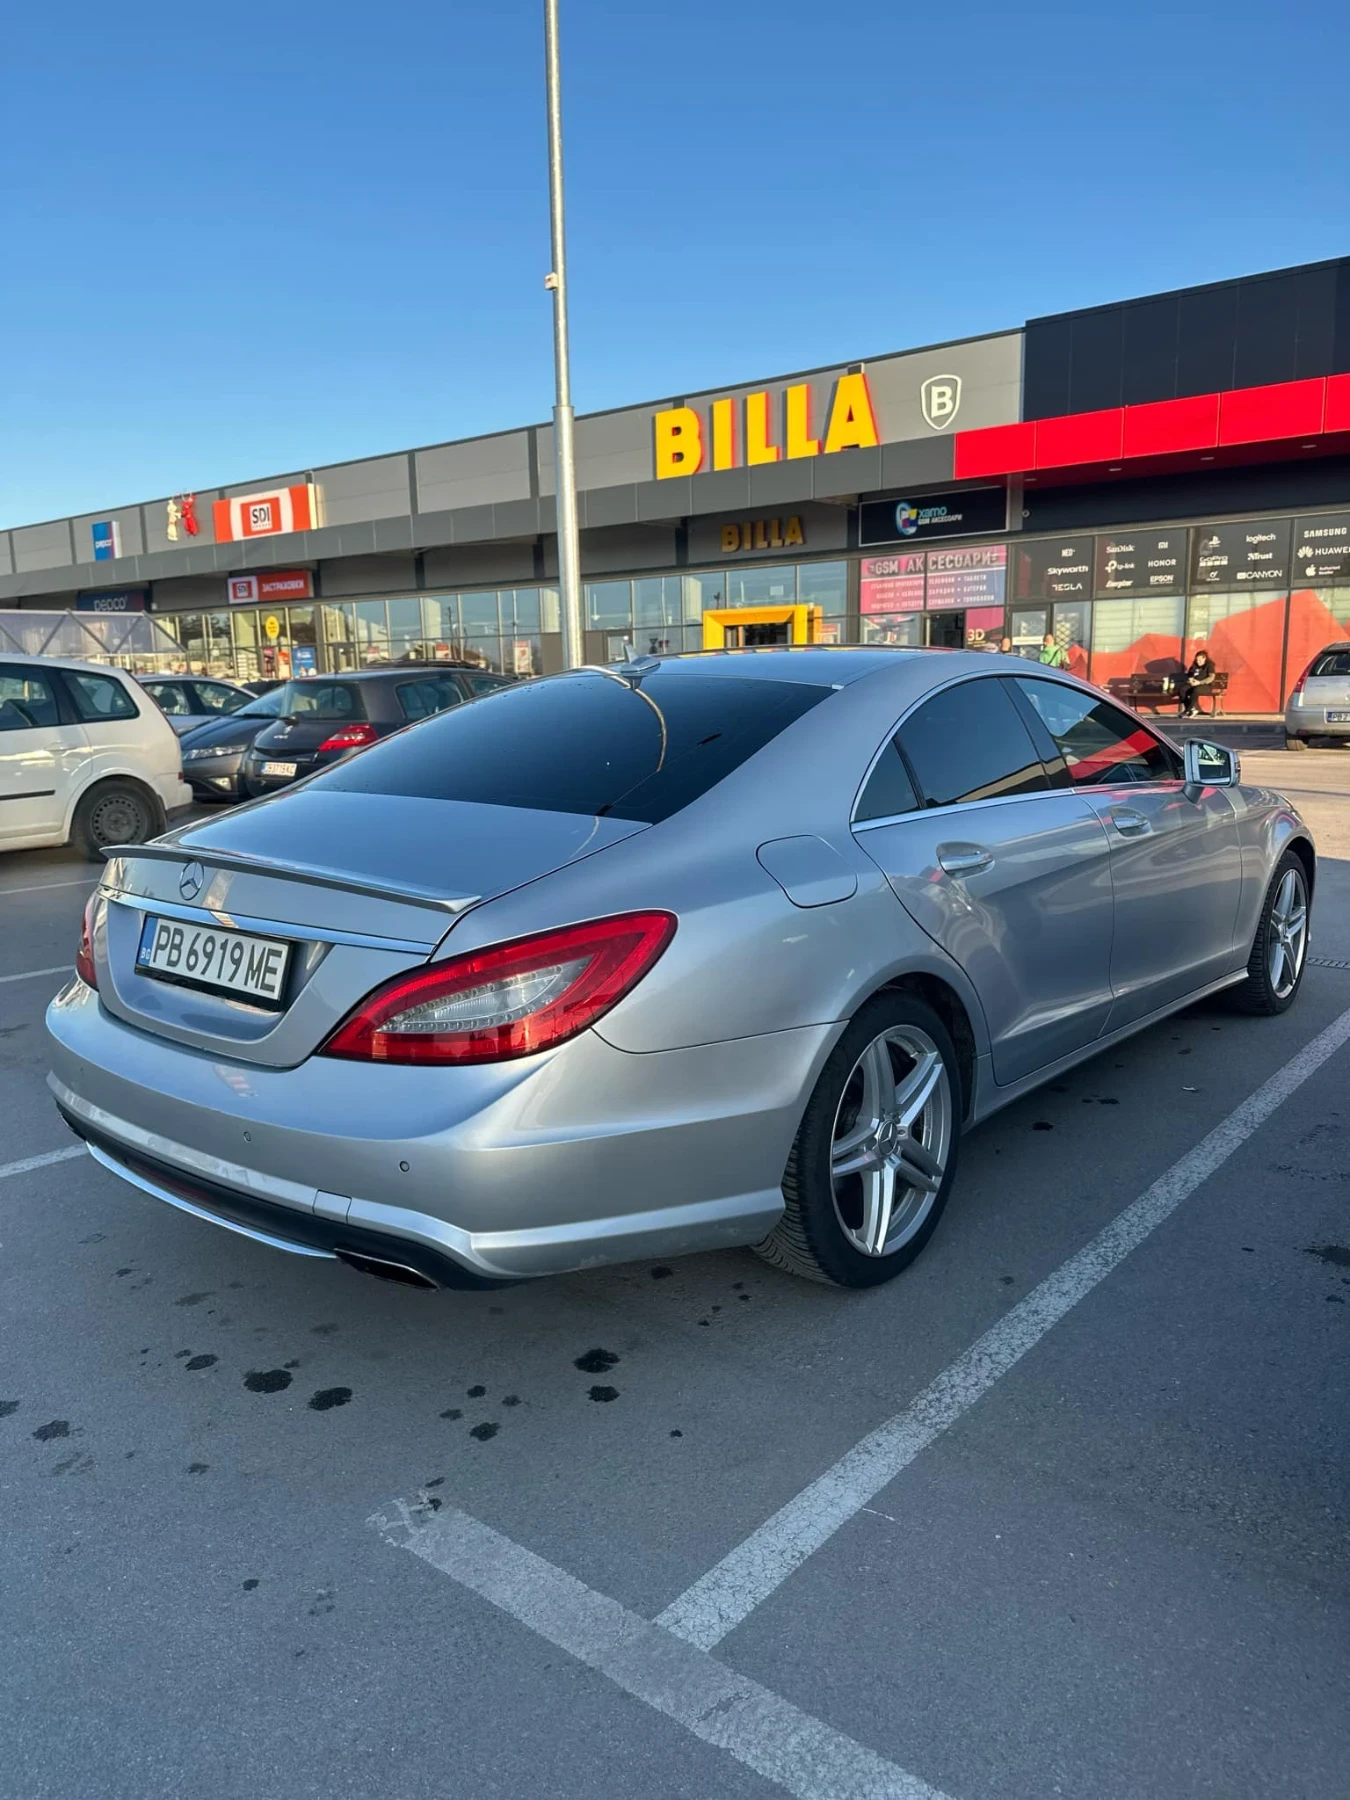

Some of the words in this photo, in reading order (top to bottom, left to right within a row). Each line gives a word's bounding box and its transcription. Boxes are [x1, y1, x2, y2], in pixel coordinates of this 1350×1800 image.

[931, 386, 953, 418] B
[655, 373, 880, 480] BILLA
[252, 506, 270, 524] SDI
[720, 516, 805, 552] BILLA
[1304, 527, 1347, 538] SAMSUNG
[1246, 533, 1276, 544] logitech
[1106, 544, 1135, 553] SanDisk
[875, 560, 898, 574] GSM
[1148, 559, 1176, 567] HONOR
[1047, 565, 1088, 575] Skyworth
[1246, 570, 1282, 578] CANYON
[1052, 583, 1082, 591] TESLA
[967, 628, 985, 641] 3D
